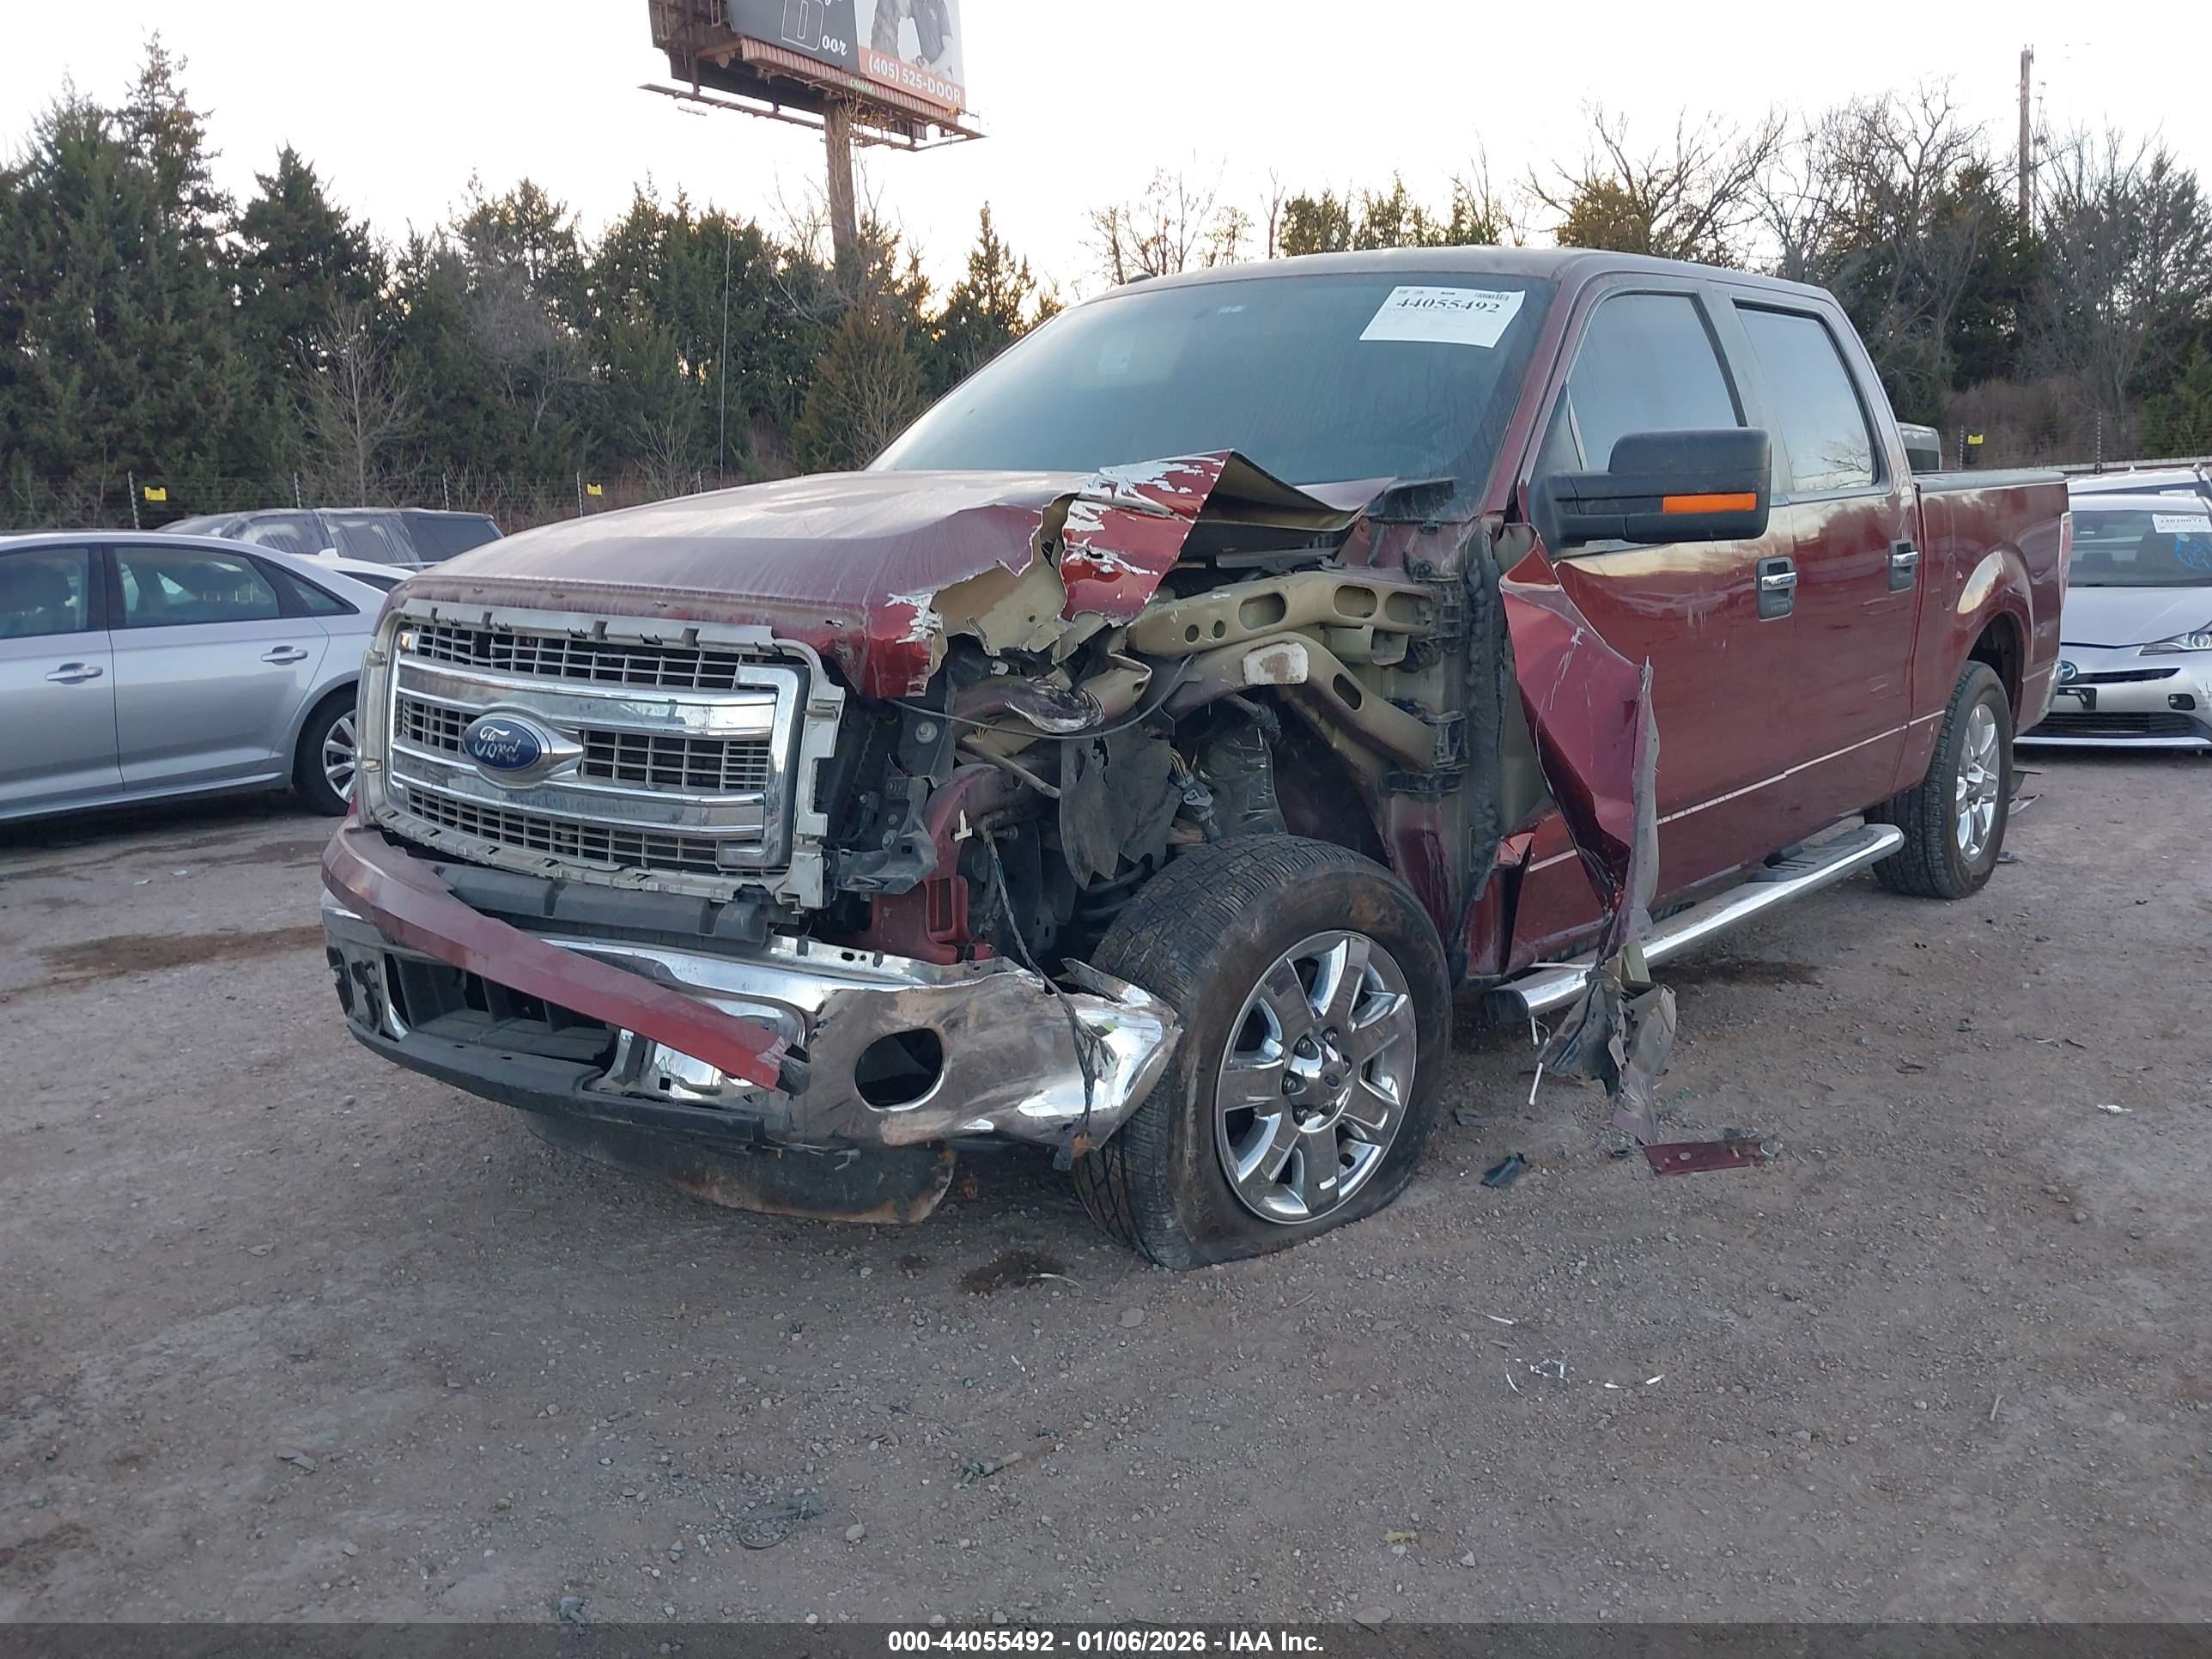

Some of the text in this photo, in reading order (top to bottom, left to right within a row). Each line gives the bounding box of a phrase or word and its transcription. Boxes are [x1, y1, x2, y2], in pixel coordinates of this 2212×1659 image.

[868, 55, 961, 104] (405) 525-DOOR
[1396, 297, 1500, 313] 44055492
[474, 726, 521, 763] Ford
